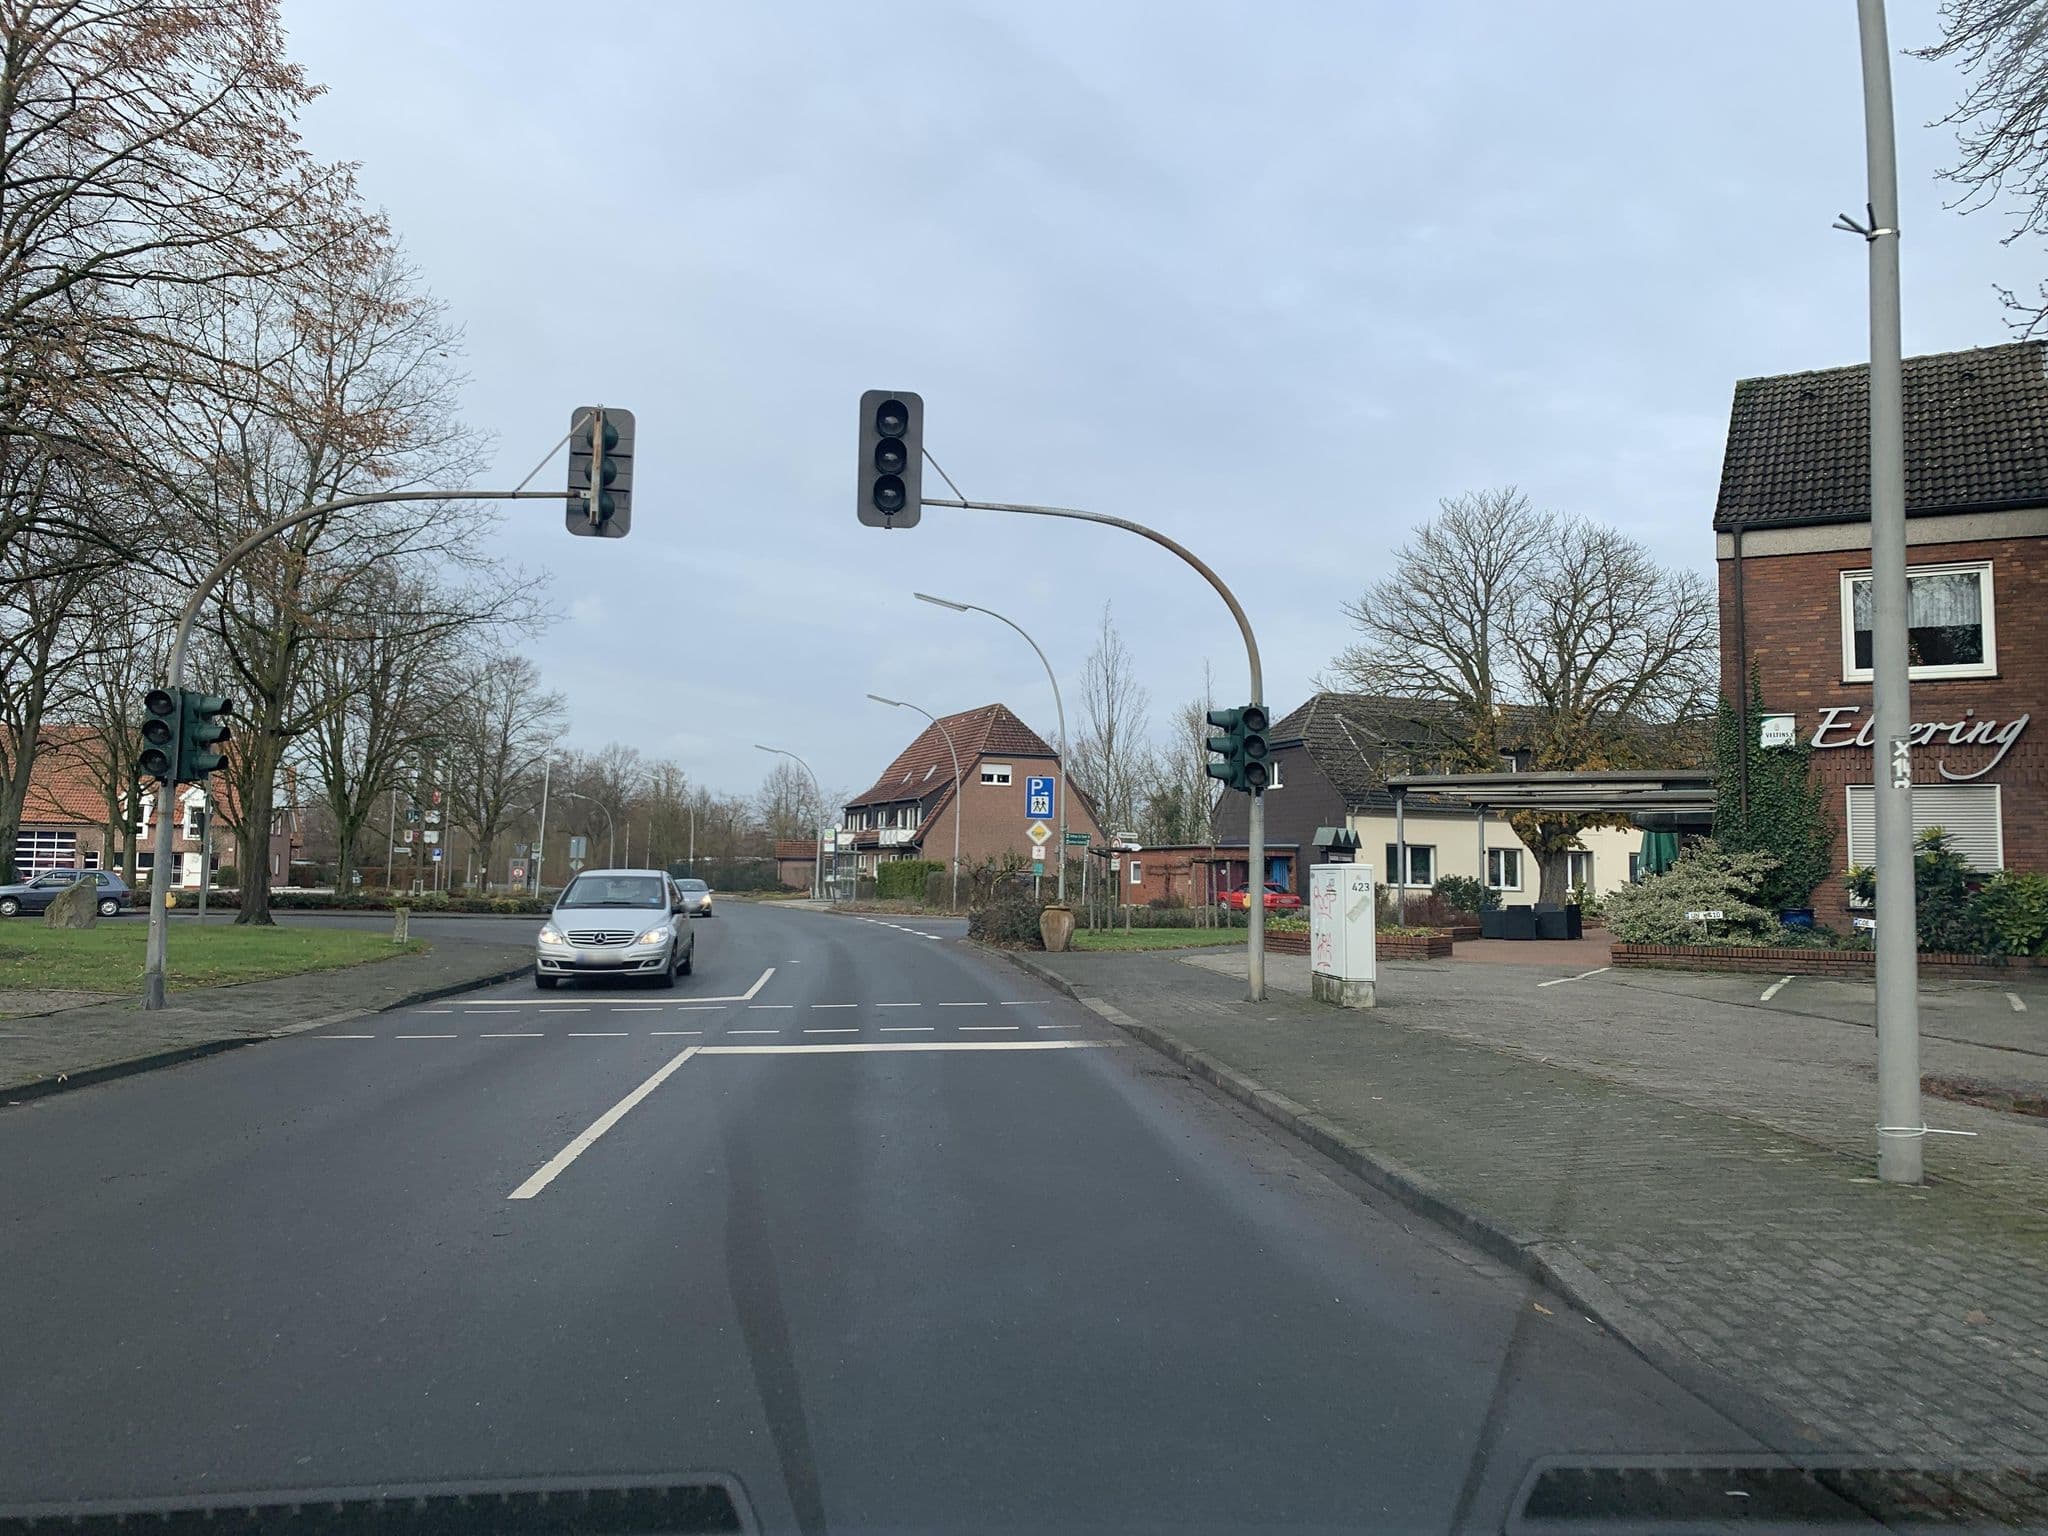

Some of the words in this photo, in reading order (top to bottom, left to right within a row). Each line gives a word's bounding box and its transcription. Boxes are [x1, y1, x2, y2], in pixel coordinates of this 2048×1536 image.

[1811, 705, 2030, 781] Elering
[1031, 779, 1043, 795] P
[1352, 883, 1370, 892] 423
